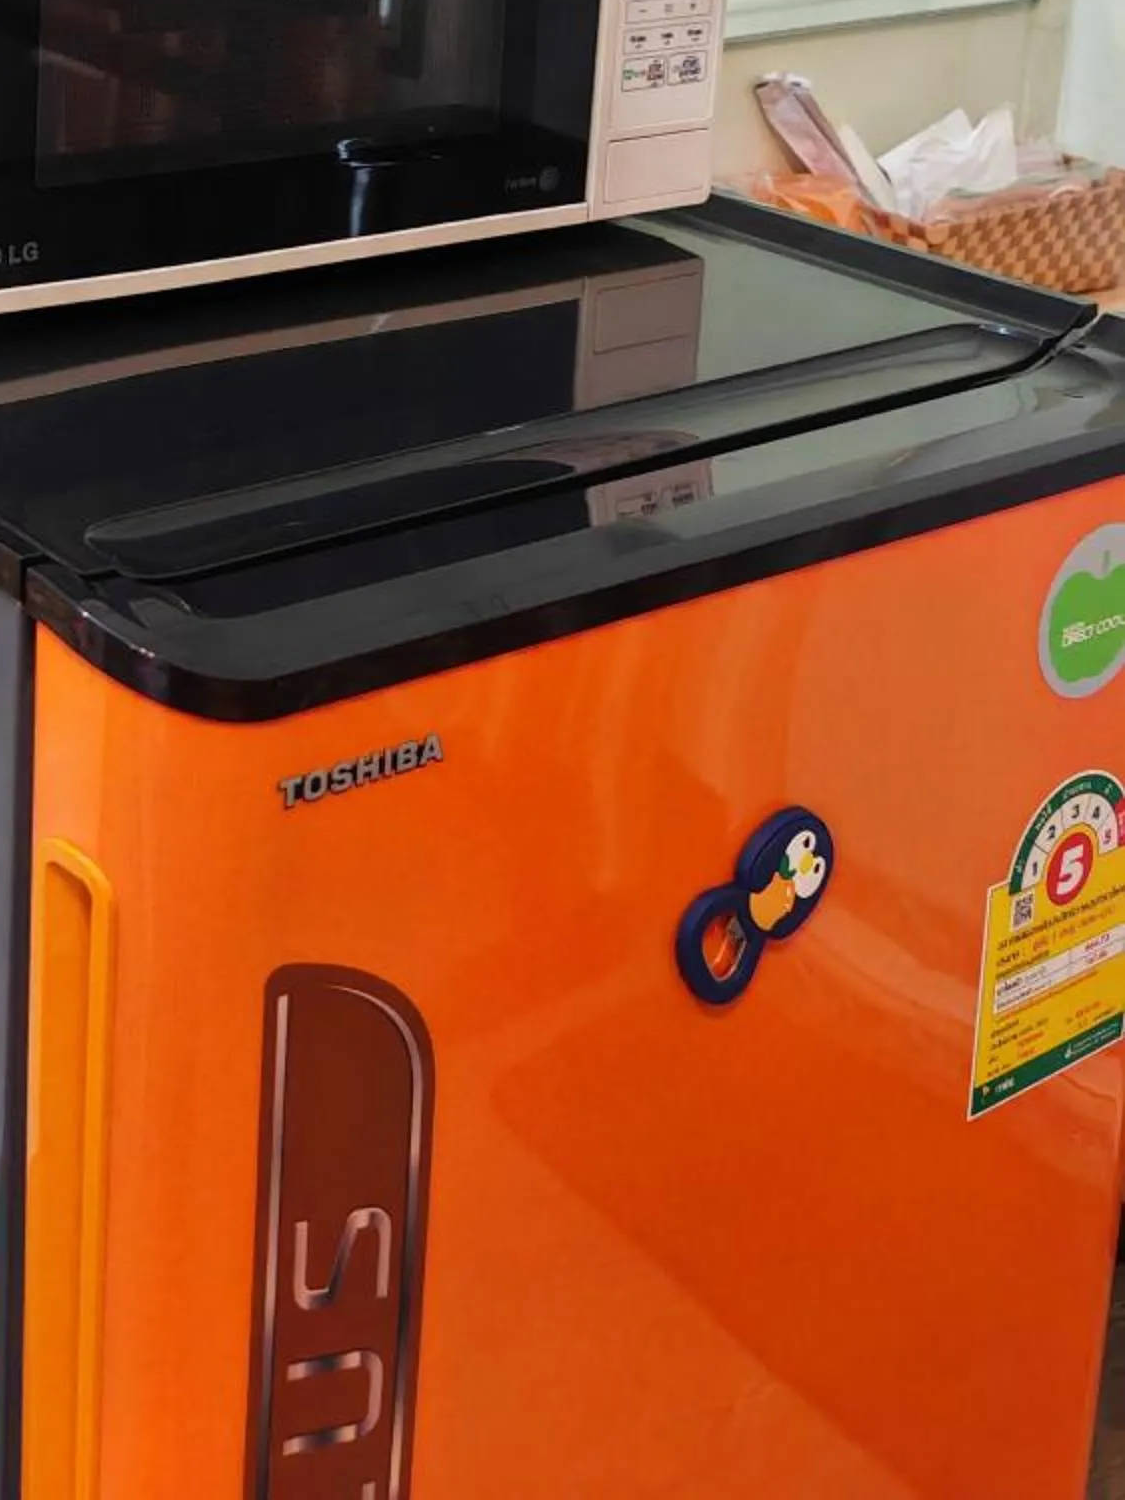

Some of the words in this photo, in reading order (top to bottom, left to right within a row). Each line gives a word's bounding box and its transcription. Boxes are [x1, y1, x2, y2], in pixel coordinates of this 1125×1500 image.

[8, 241, 40, 266] LG
[279, 733, 443, 810] TOSHIBA
[1056, 844, 1084, 896] 5
